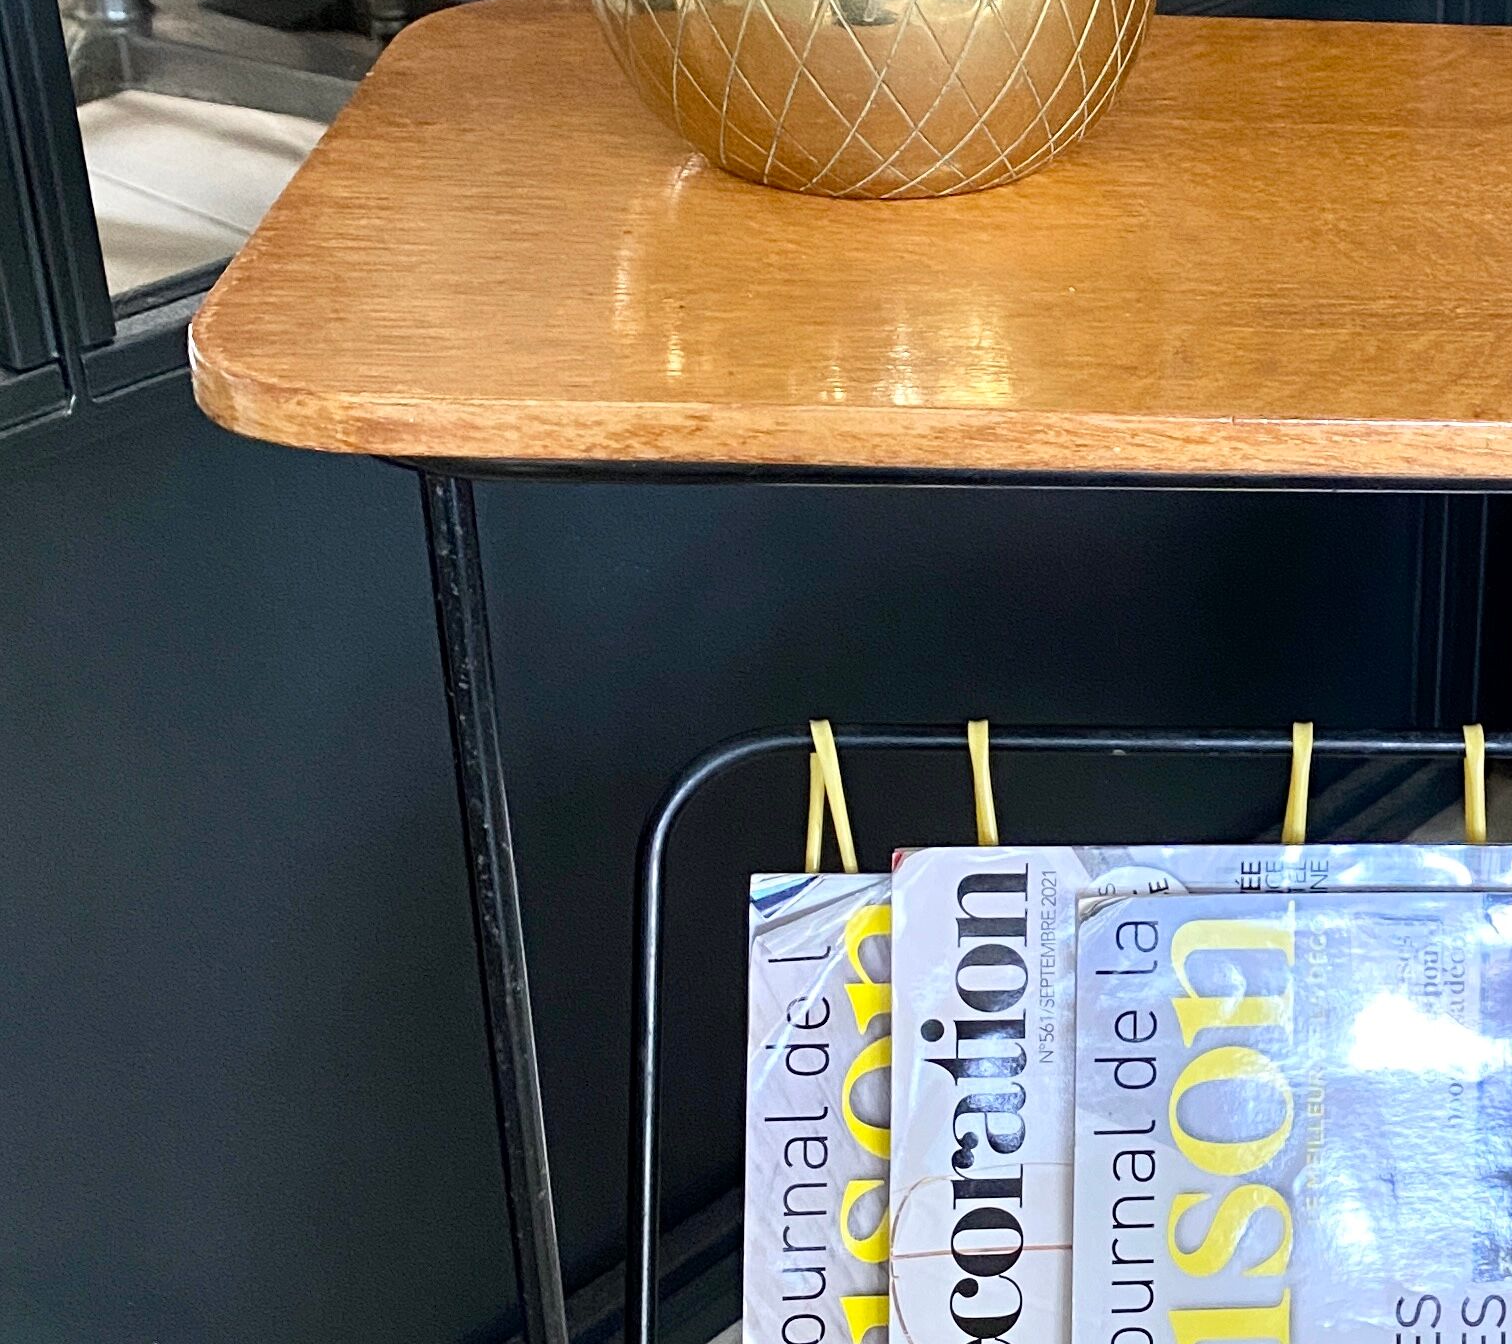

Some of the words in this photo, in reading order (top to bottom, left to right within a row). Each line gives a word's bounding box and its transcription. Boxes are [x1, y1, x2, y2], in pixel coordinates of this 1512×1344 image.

[1040, 869, 1058, 907] 2021
[1095, 919, 1160, 976] la
[765, 995, 831, 1077] de
[1093, 1009, 1158, 1090] de
